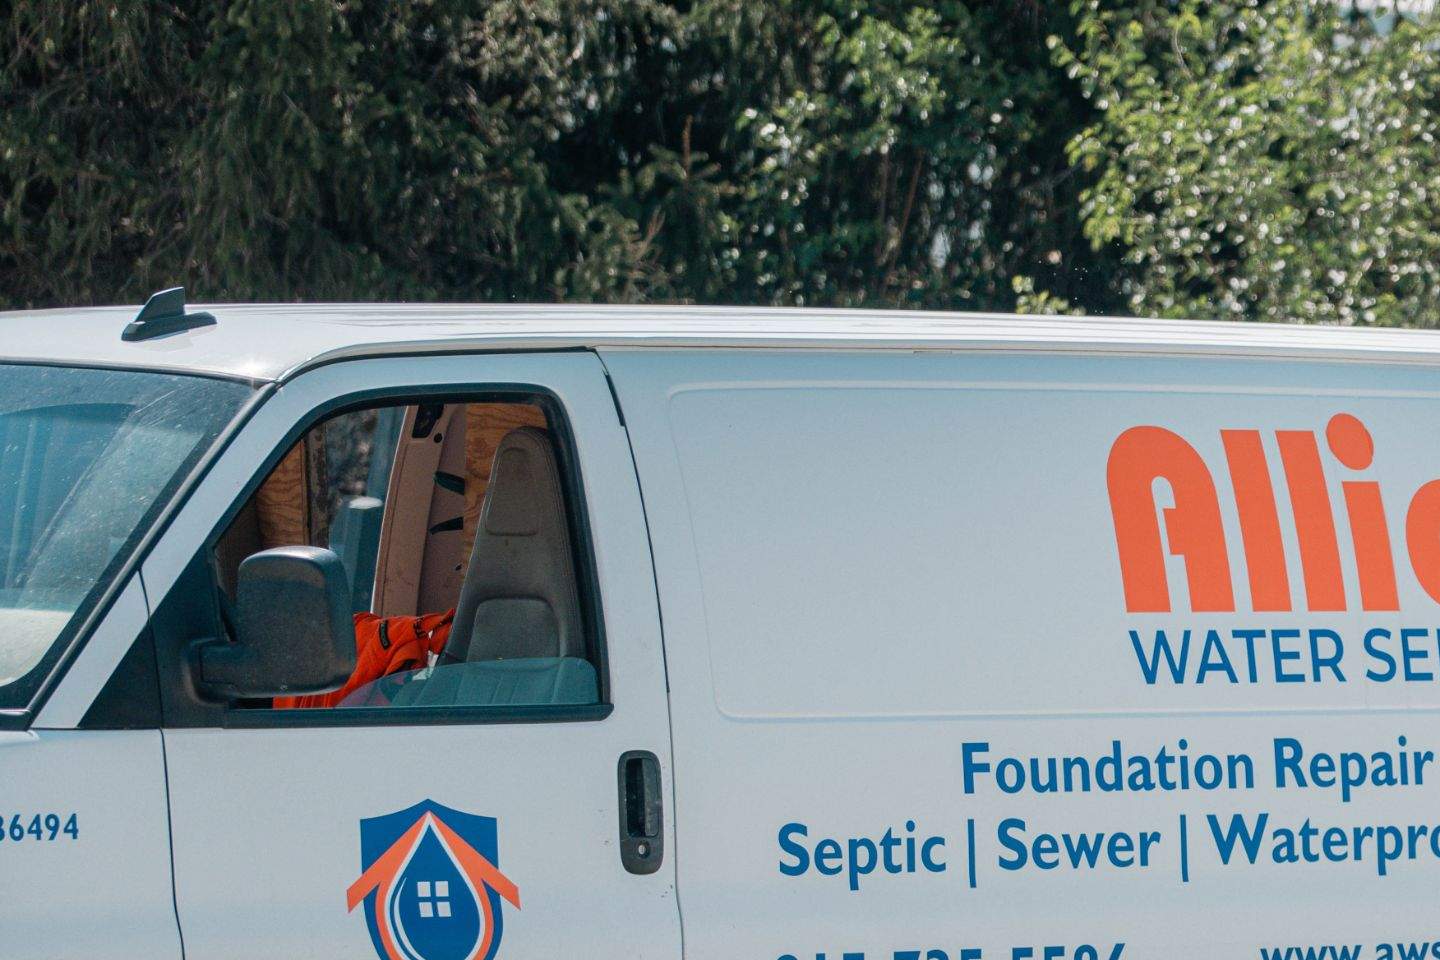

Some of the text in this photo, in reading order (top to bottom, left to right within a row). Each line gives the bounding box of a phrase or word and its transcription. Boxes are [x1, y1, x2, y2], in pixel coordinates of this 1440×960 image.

[1128, 628, 1347, 685] WATER
[962, 738, 1254, 794] Foundation
[1274, 735, 1434, 803] Repair
[778, 819, 946, 891] Septic
[998, 817, 1162, 871] Sewer
